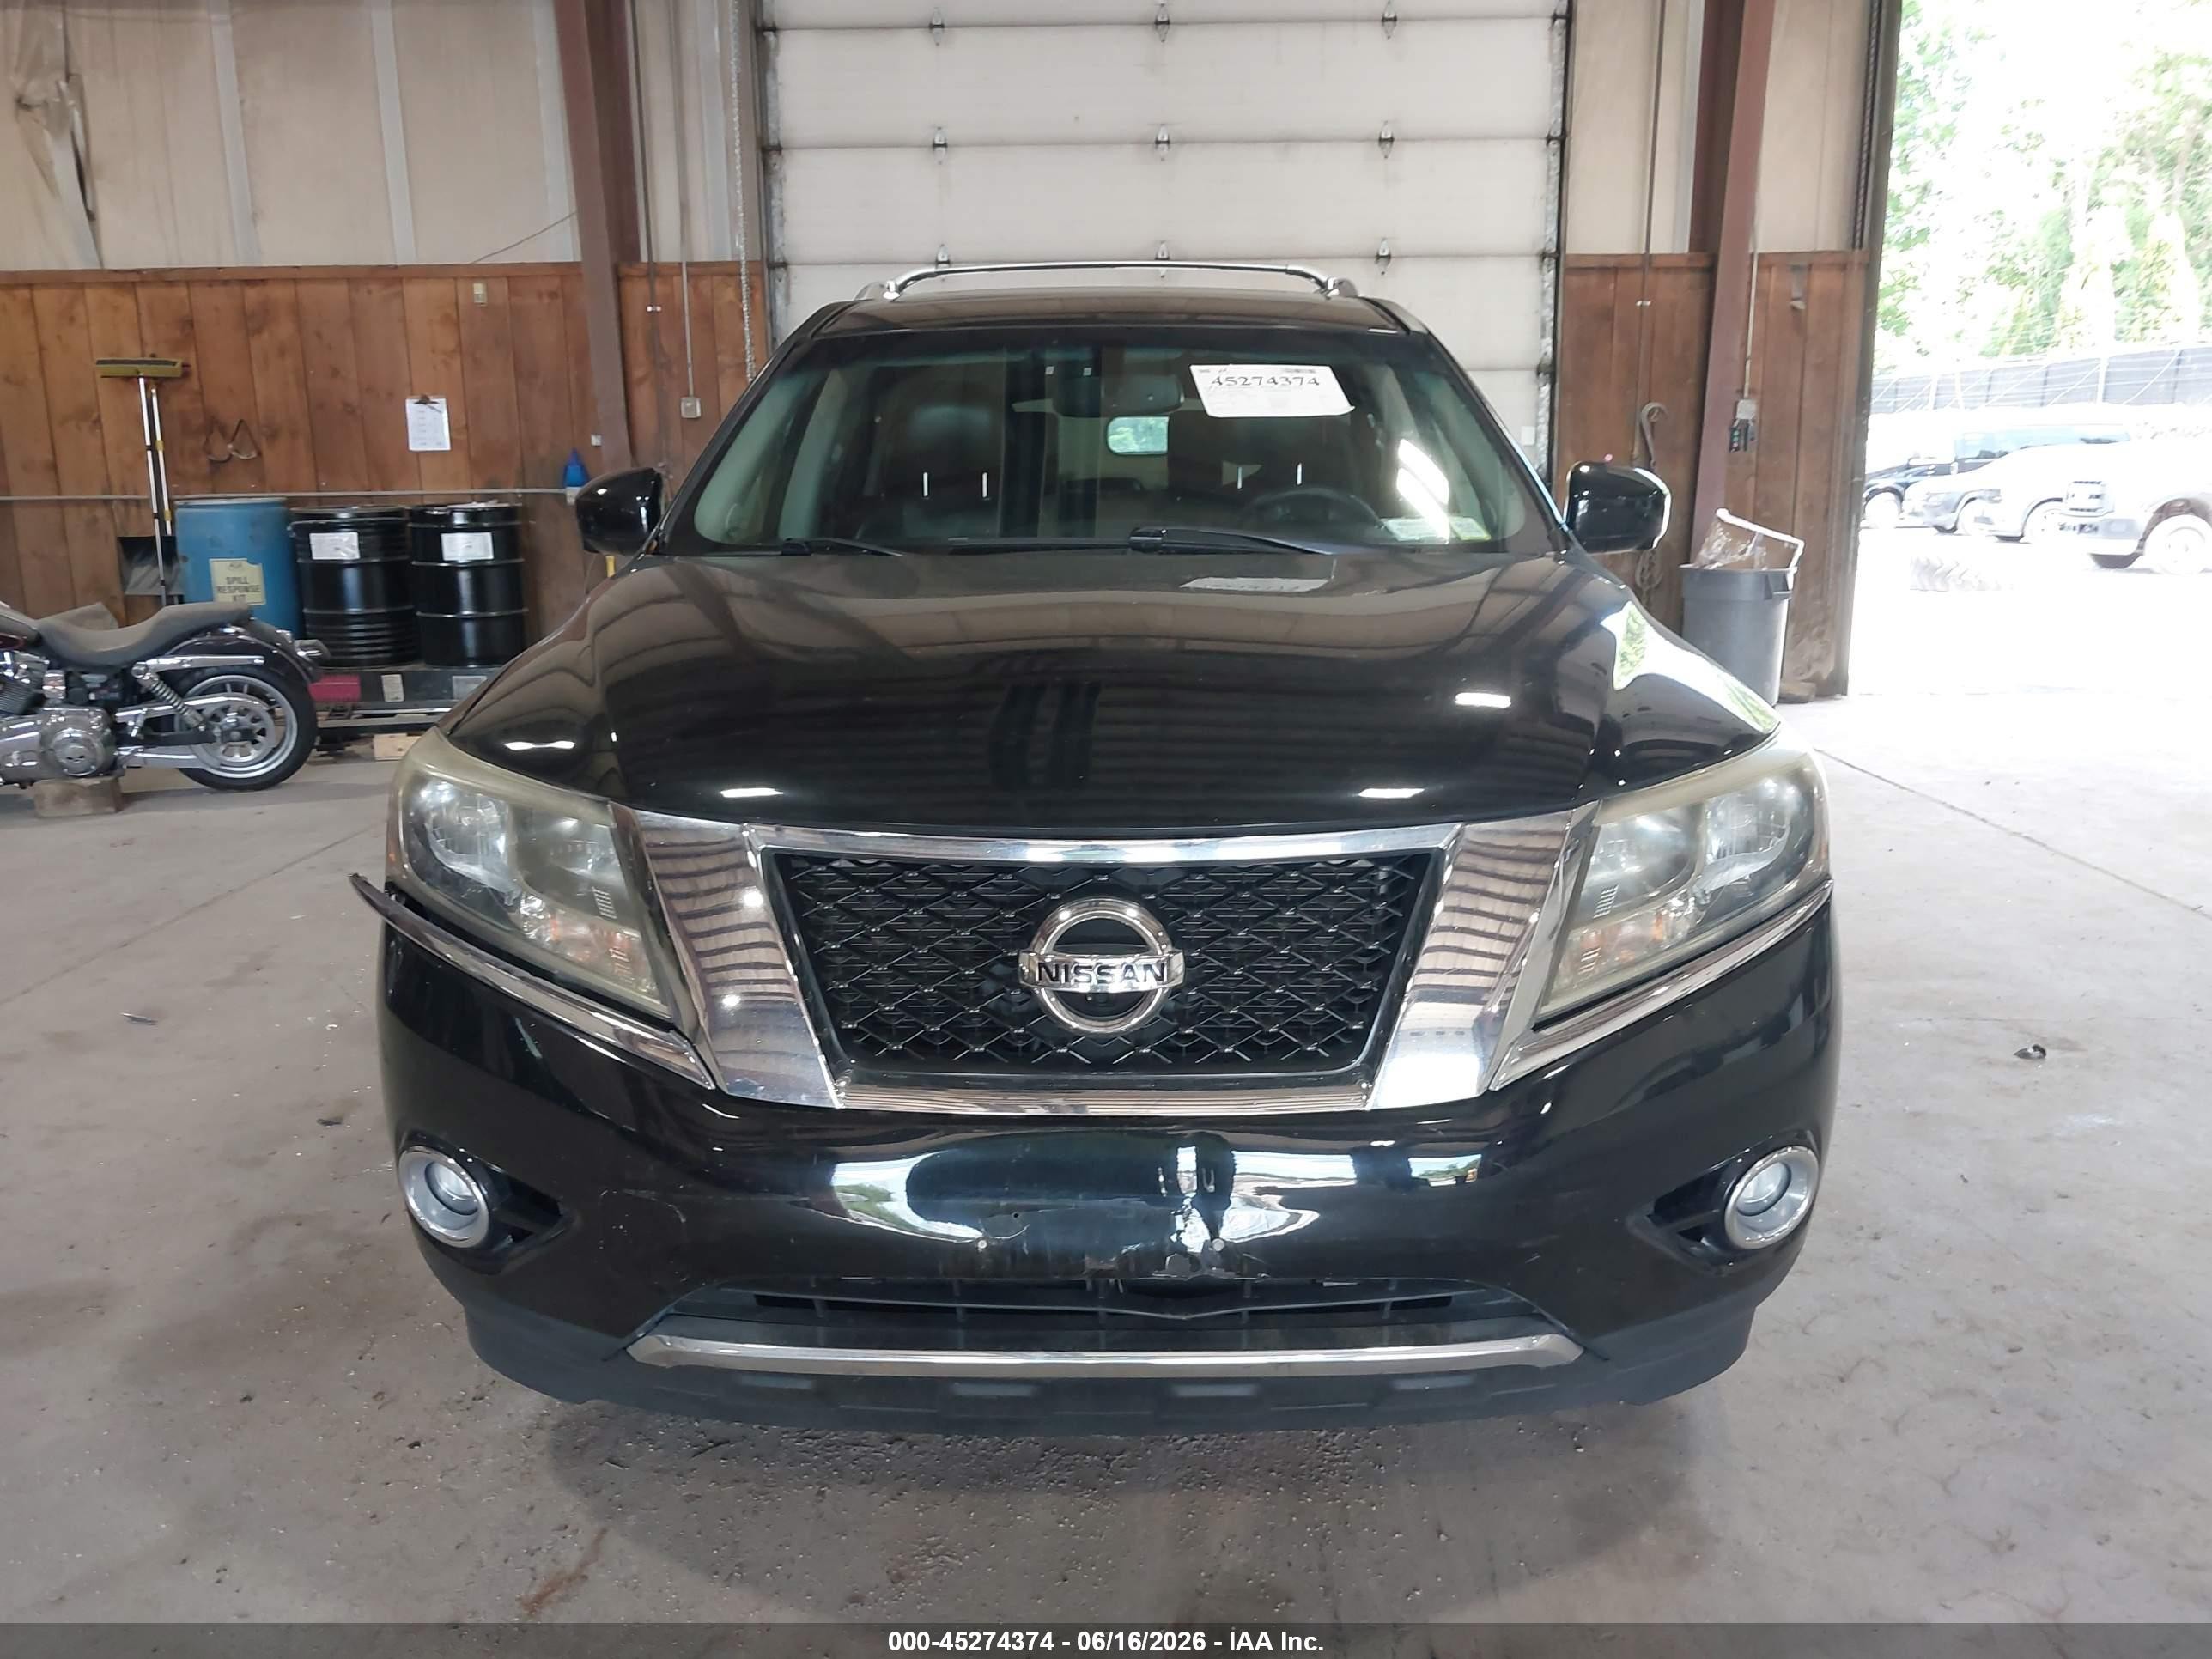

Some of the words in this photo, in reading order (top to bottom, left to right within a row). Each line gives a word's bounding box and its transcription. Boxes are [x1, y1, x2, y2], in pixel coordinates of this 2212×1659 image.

[1211, 375, 1320, 386] 45274374
[216, 585, 261, 593] RESPONSE
[1036, 961, 1166, 984] NISSAN
